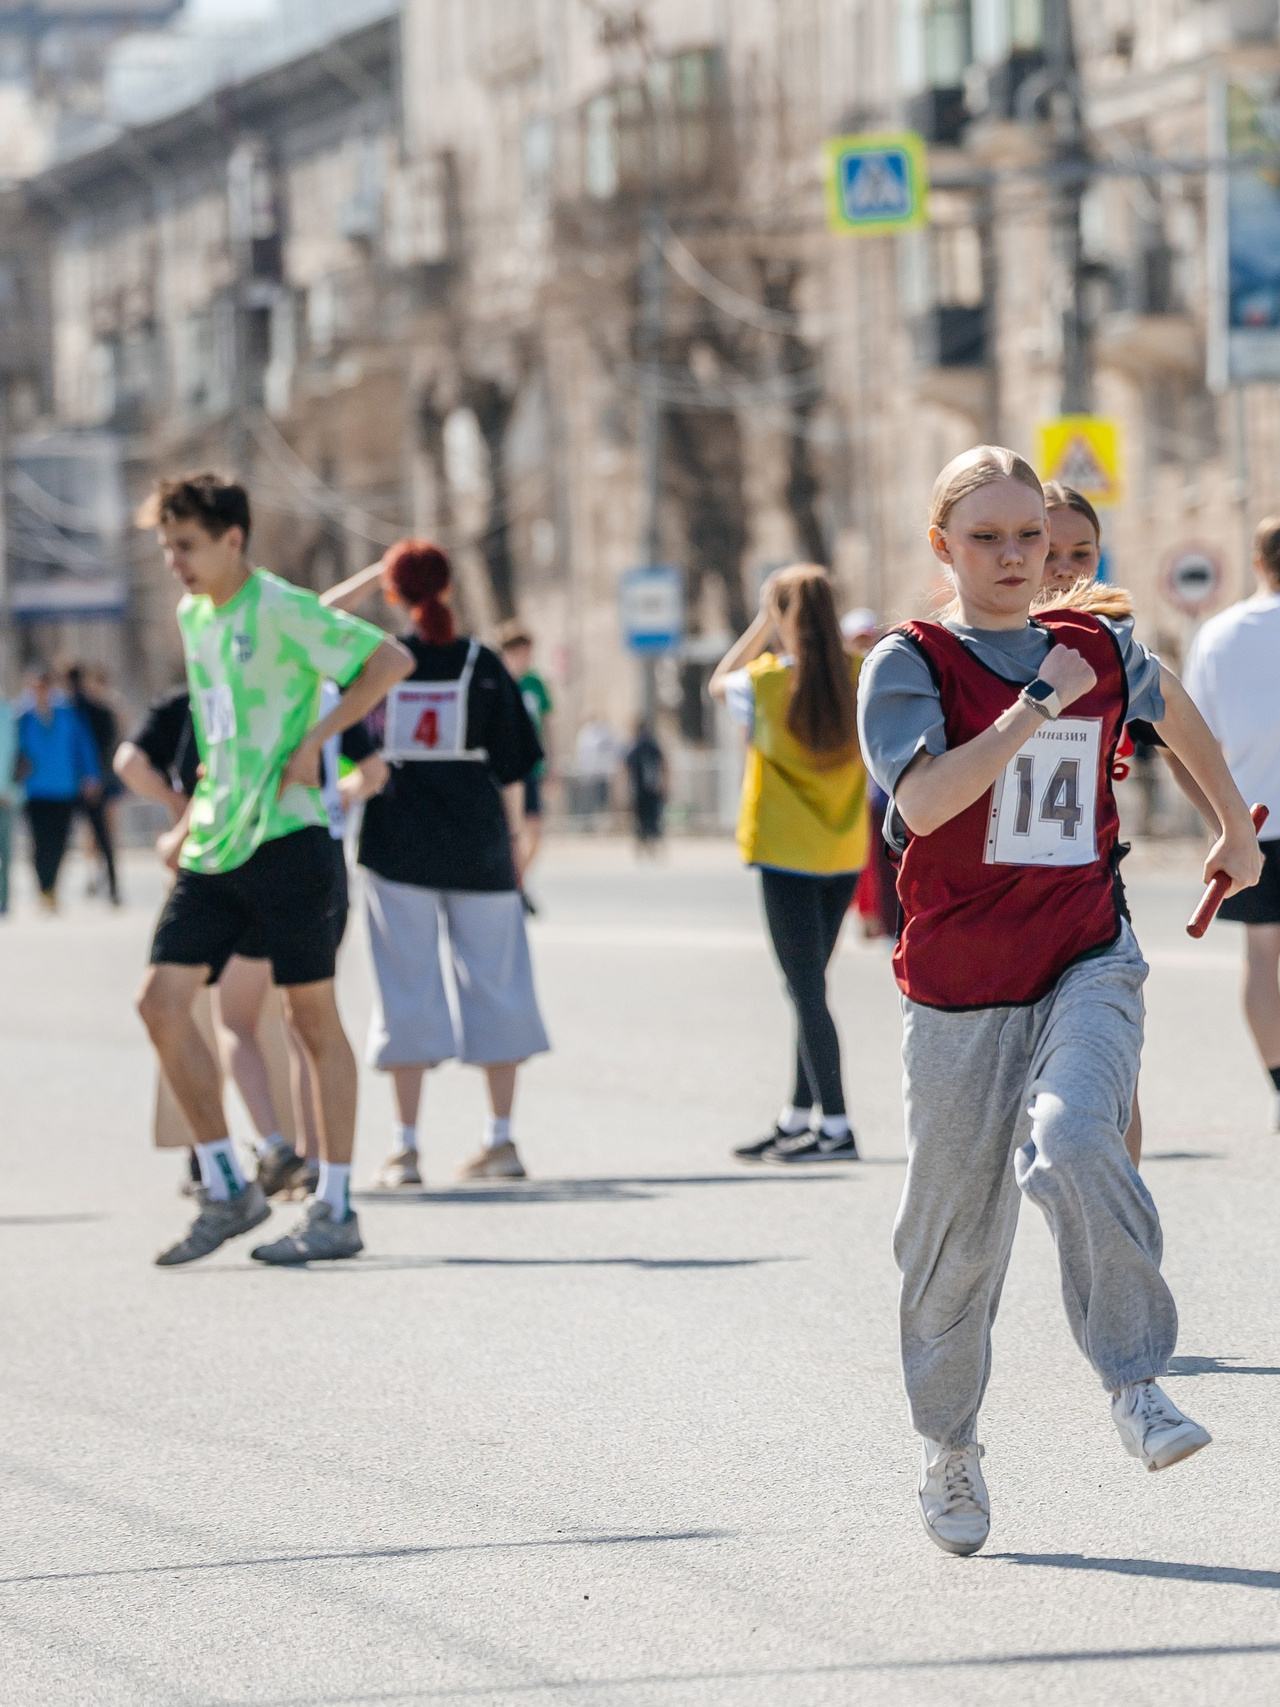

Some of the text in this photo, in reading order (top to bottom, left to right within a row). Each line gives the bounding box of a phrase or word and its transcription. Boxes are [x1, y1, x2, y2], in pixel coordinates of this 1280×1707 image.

[413, 709, 439, 748] 4
[1032, 730, 1087, 742] мназия
[1013, 754, 1083, 840] 14
